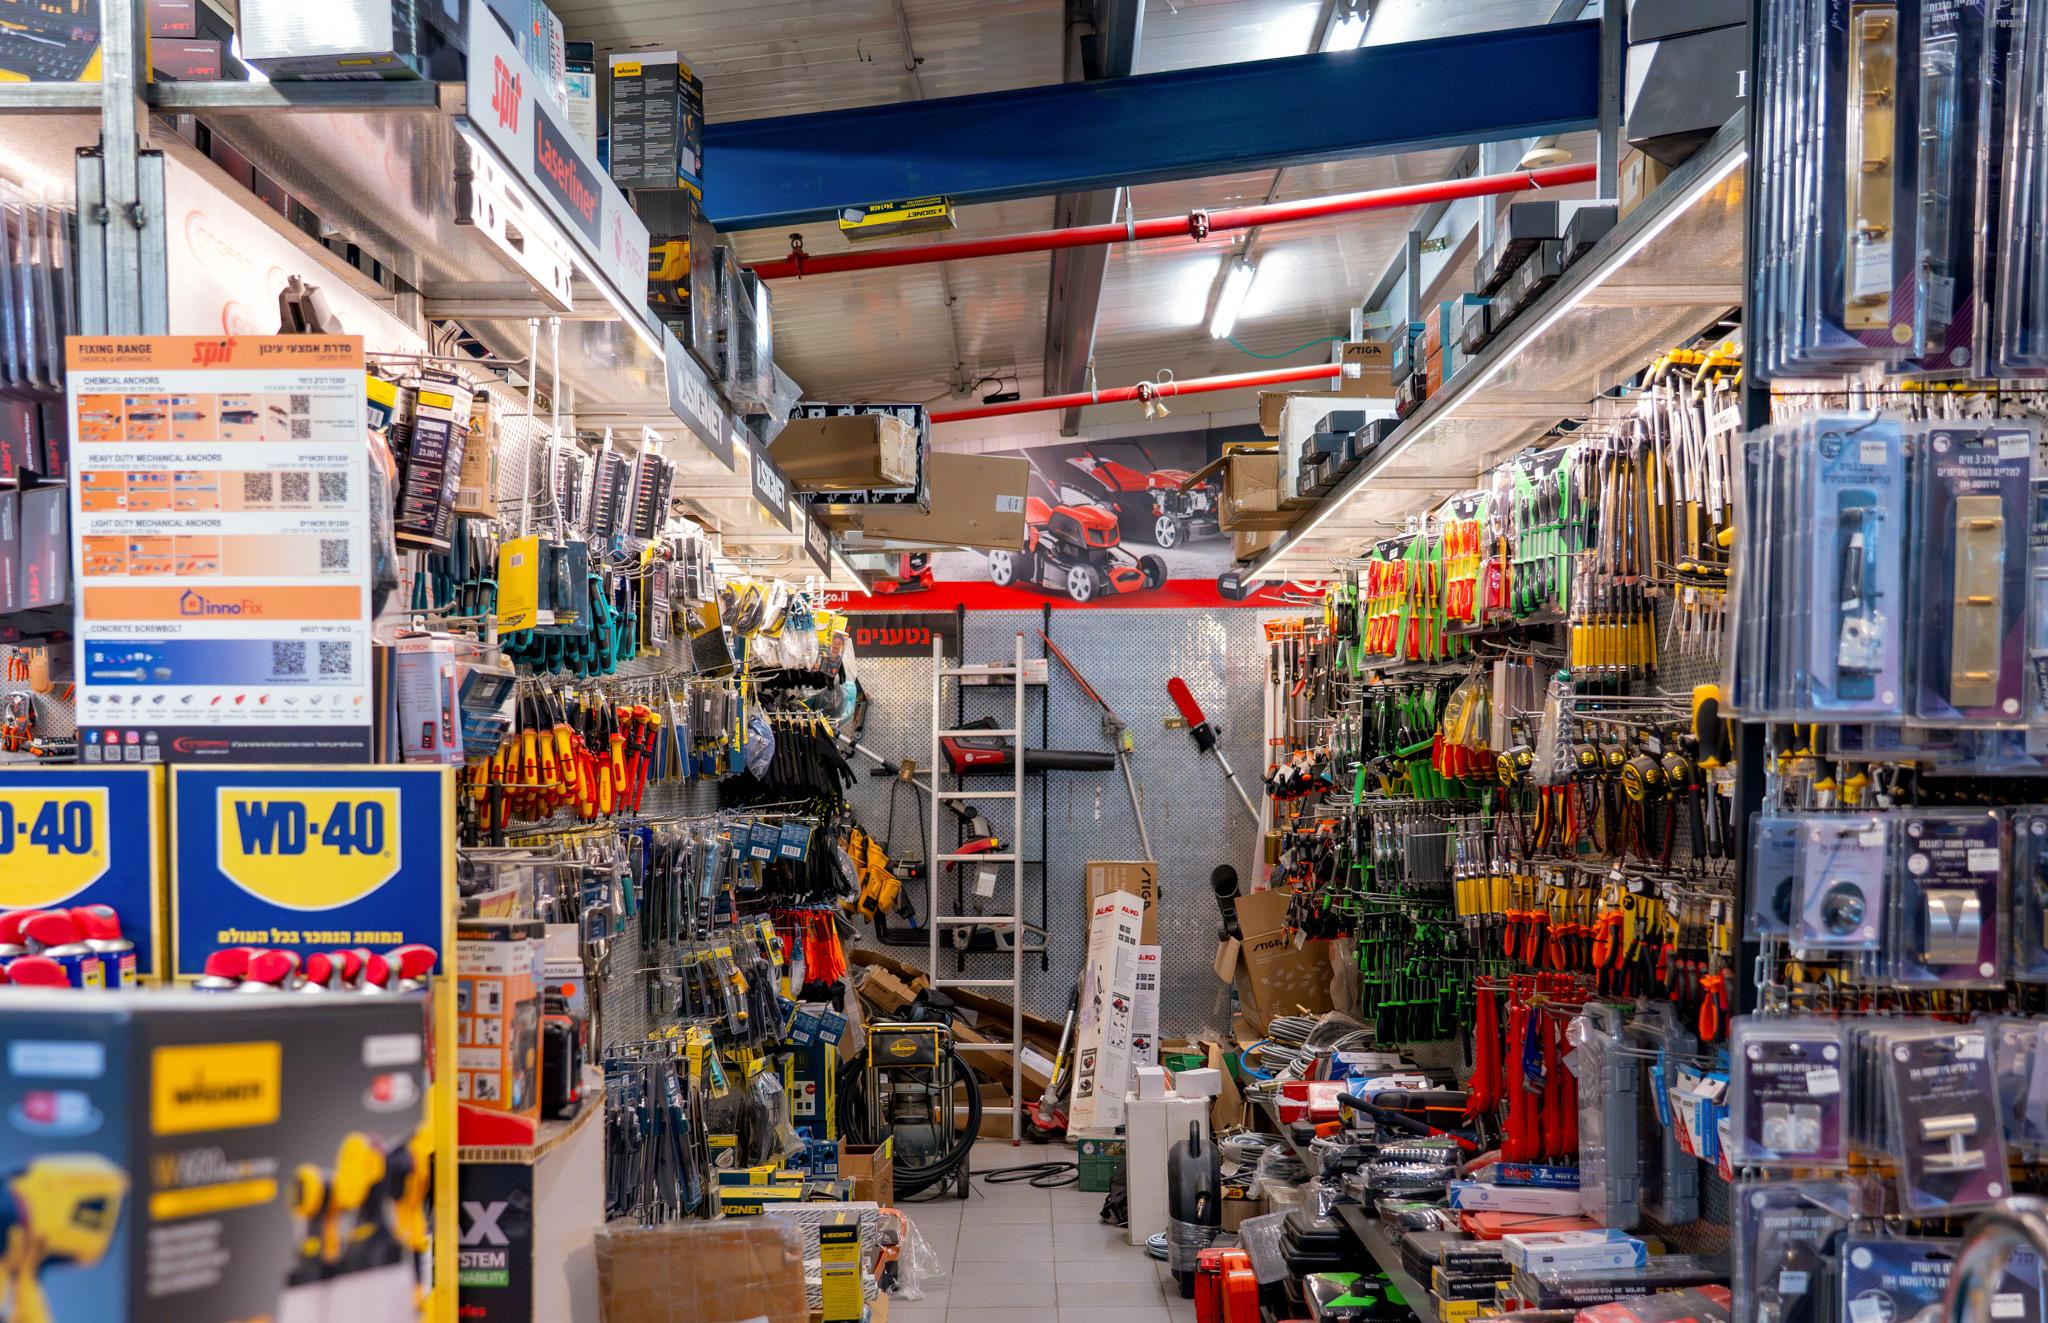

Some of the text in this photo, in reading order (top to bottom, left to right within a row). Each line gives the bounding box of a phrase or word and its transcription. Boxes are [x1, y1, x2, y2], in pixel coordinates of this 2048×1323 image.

[537, 119, 599, 224] Laserliner
[79, 344, 152, 354] FIXING RANGE
[191, 338, 238, 367] spit
[287, 344, 320, 353] אמצעי
[324, 343, 352, 353] סדרת
[1348, 346, 1382, 354] STIGA
[685, 374, 724, 444] SIGNET
[89, 454, 222, 462] HEAVY DUTY MECHANICAL ANCHORS
[762, 466, 786, 513] SIGNET
[206, 600, 263, 615] innoFix
[91, 625, 133, 633] CONCRETE
[856, 628, 930, 646] נטענים
[234, 801, 386, 855] WD-40
[217, 928, 404, 943] המותג הנמכר בכל העולם
[459, 1200, 510, 1246] X
[459, 1252, 506, 1268] STEM
[1573, 1293, 1613, 1302] VANADIUM
